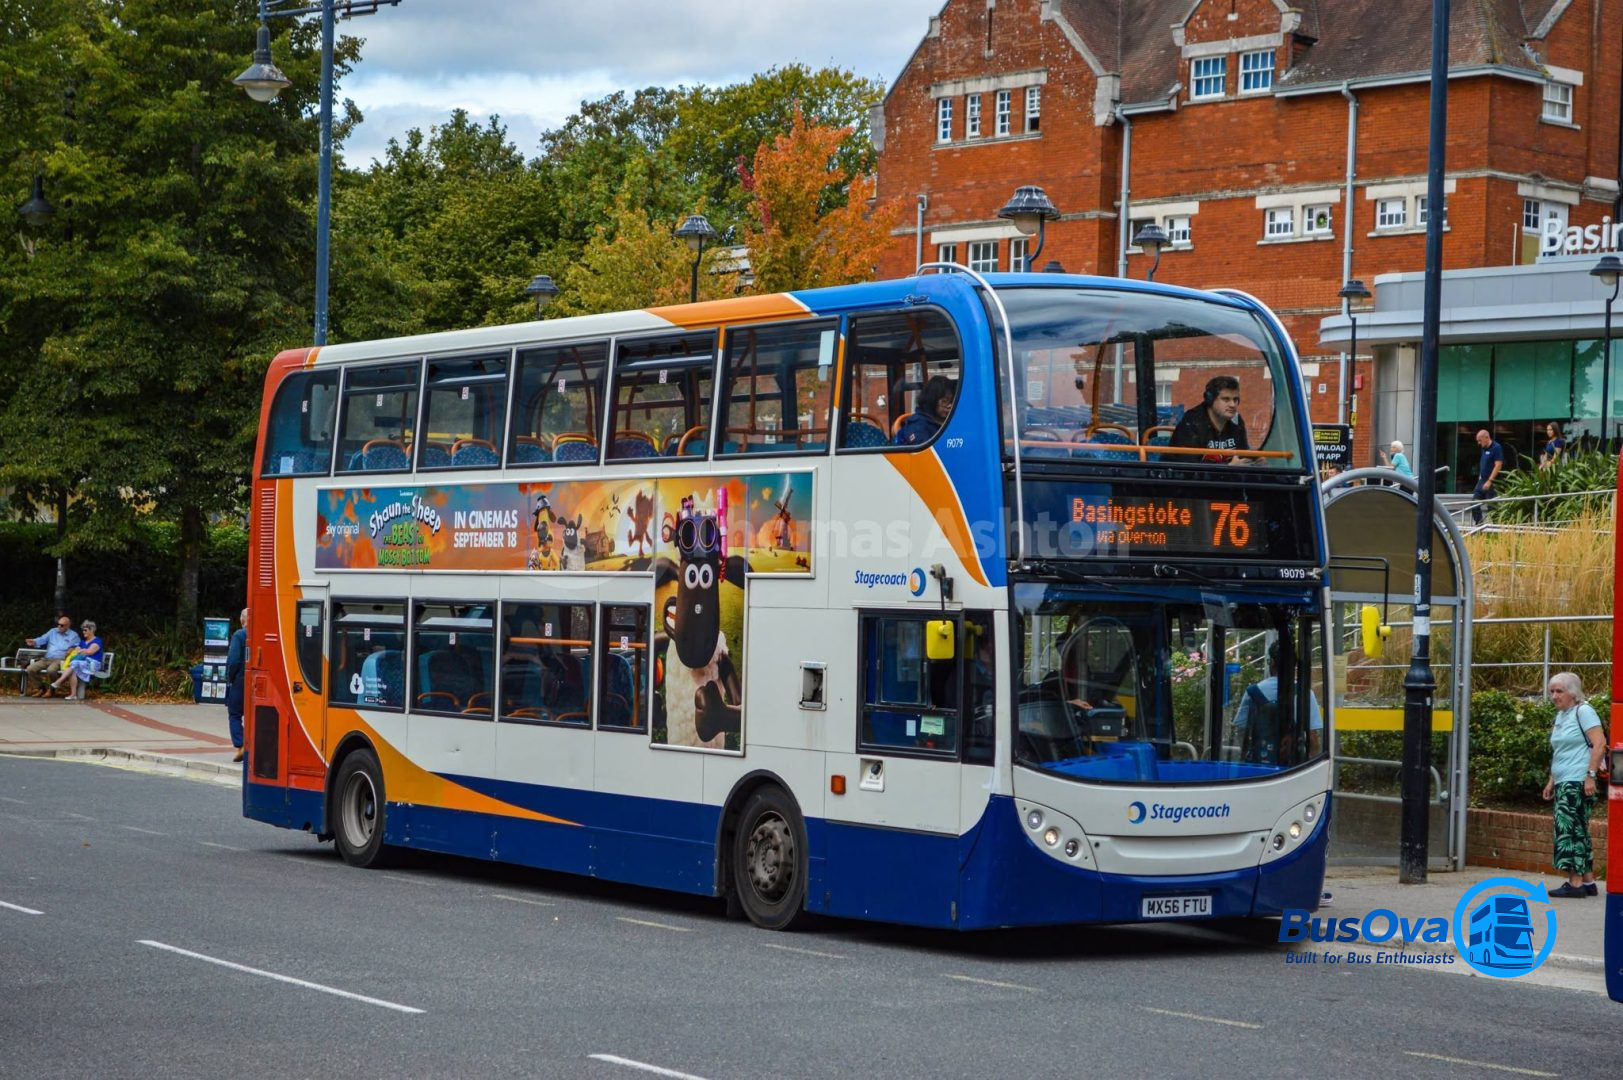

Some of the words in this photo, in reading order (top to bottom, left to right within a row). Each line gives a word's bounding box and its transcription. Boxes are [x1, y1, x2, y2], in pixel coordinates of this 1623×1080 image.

[946, 438, 964, 448] 19079
[1315, 444, 1347, 452] WNLOAD
[369, 501, 401, 537] Shaun
[402, 503, 411, 514] the
[411, 495, 441, 535] Sheep
[454, 511, 466, 528] IN
[468, 509, 518, 529] CINEMAS
[1072, 498, 1192, 529] Basingstoke
[326, 523, 336, 536] sky
[337, 521, 360, 537] original
[1210, 502, 1250, 547] 76
[453, 531, 504, 548] SEPTEMBER
[507, 531, 517, 548] 18
[1096, 530, 1115, 544] via
[854, 570, 907, 589] Stagecoach
[1279, 567, 1306, 579] 19079
[1150, 802, 1230, 823] Stagecoach
[1147, 899, 1180, 915] MX56
[1183, 897, 1207, 914] FTU
